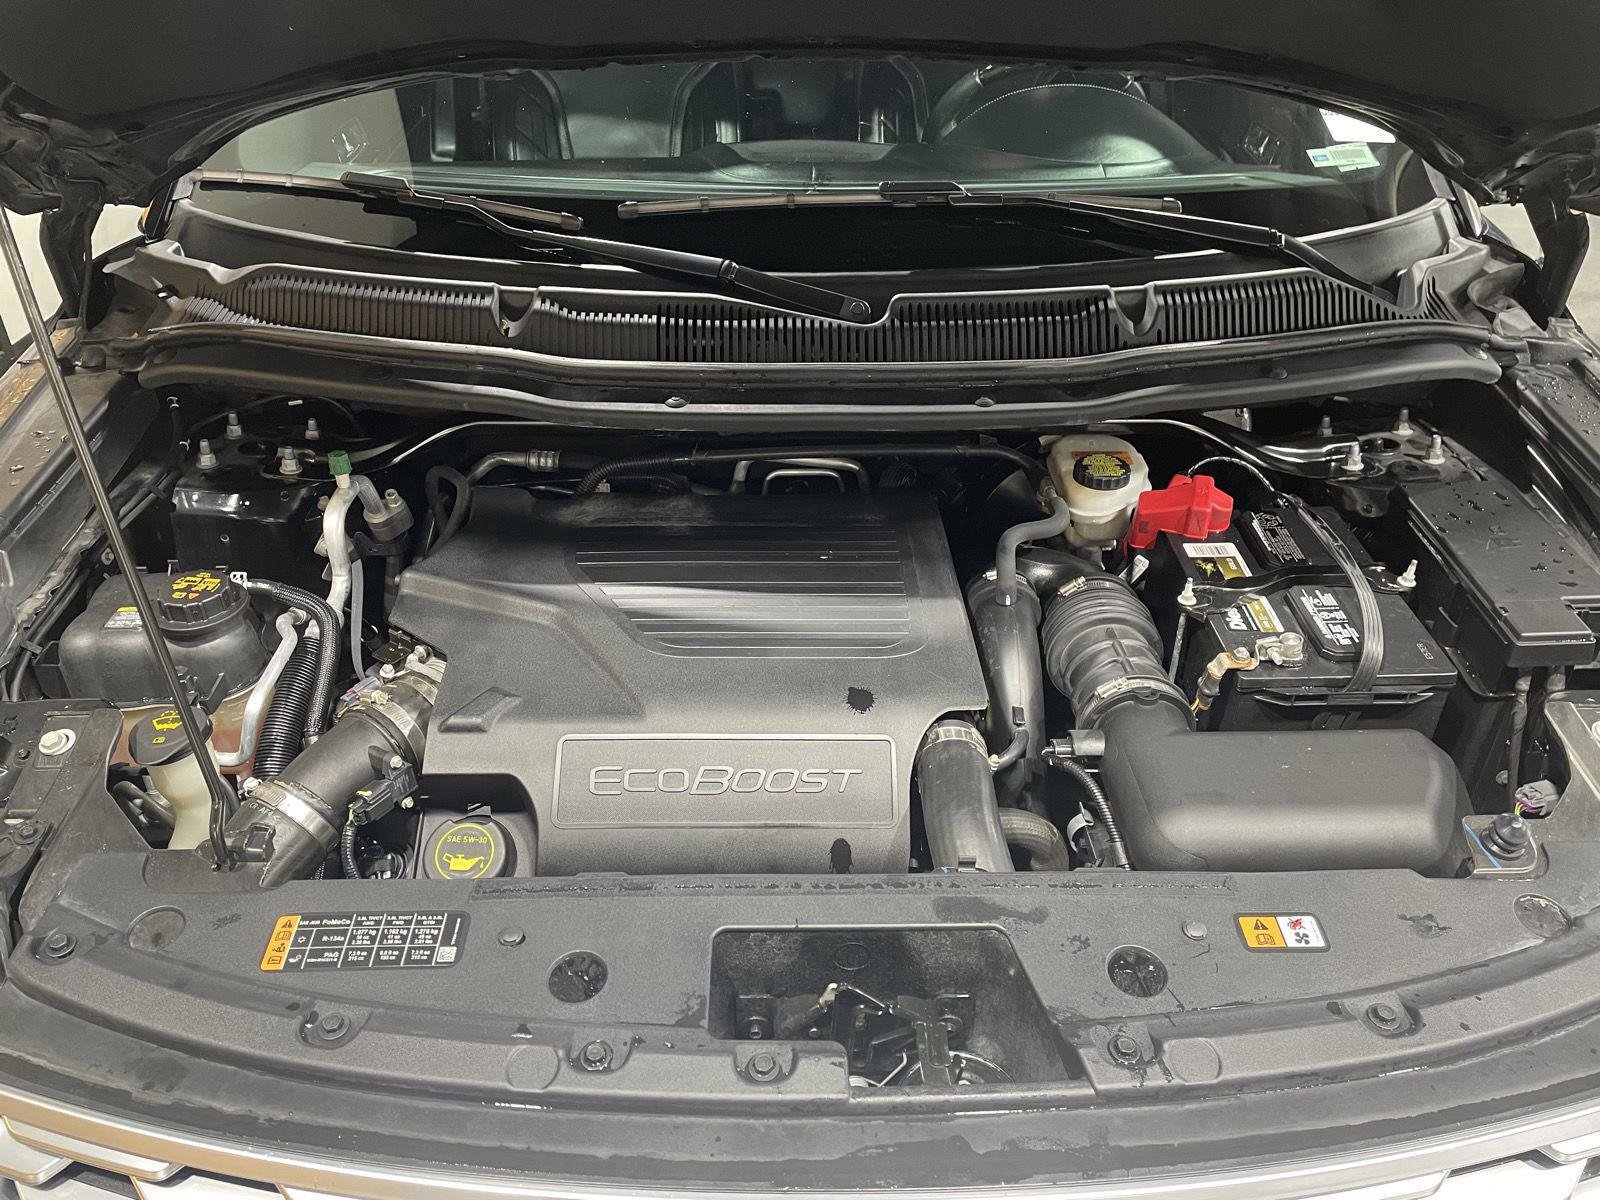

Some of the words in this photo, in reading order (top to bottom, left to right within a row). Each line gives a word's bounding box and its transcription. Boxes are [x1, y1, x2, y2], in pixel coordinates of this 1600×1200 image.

[1225, 607, 1248, 630] Die
[446, 835, 461, 843] SAE
[463, 835, 488, 844] 5W-30
